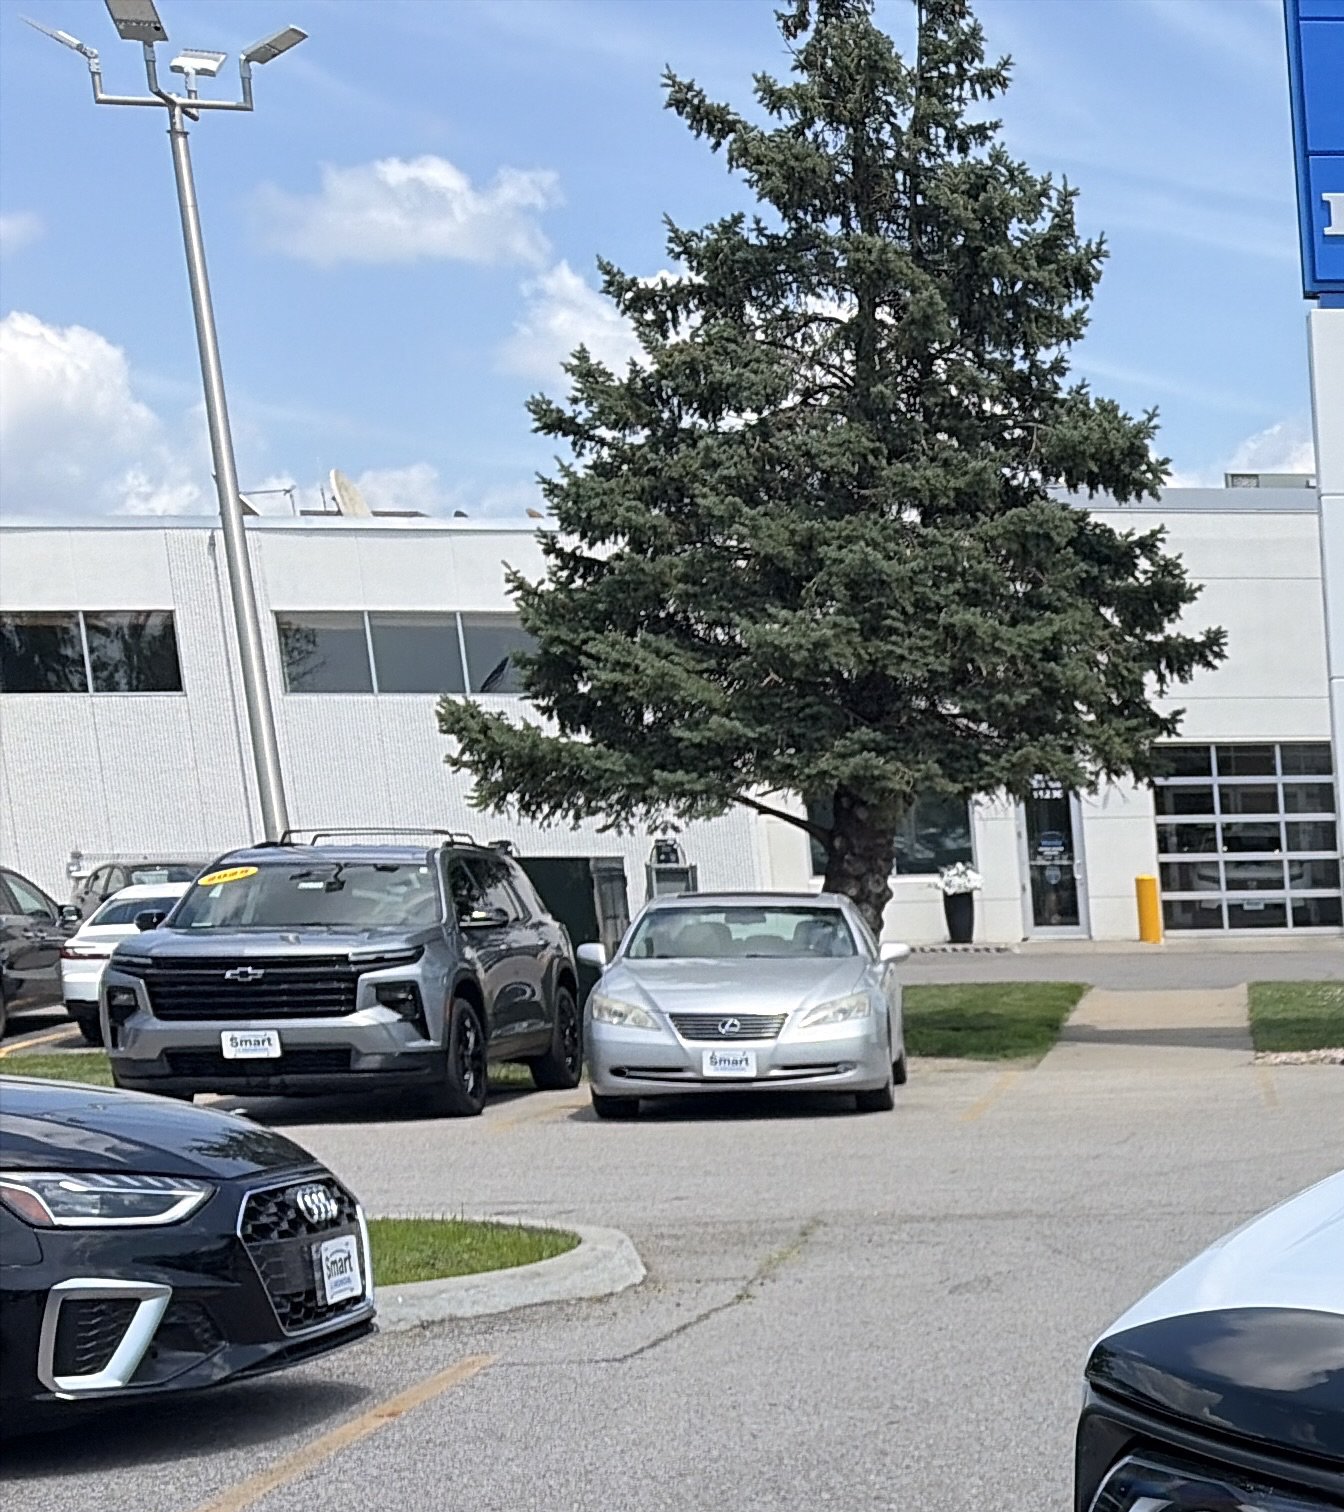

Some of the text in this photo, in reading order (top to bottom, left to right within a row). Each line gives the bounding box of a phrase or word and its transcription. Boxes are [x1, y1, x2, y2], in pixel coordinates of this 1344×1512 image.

[229, 1036, 272, 1047] Smart
[709, 1055, 749, 1066] Smart
[325, 1250, 354, 1280] Smart
